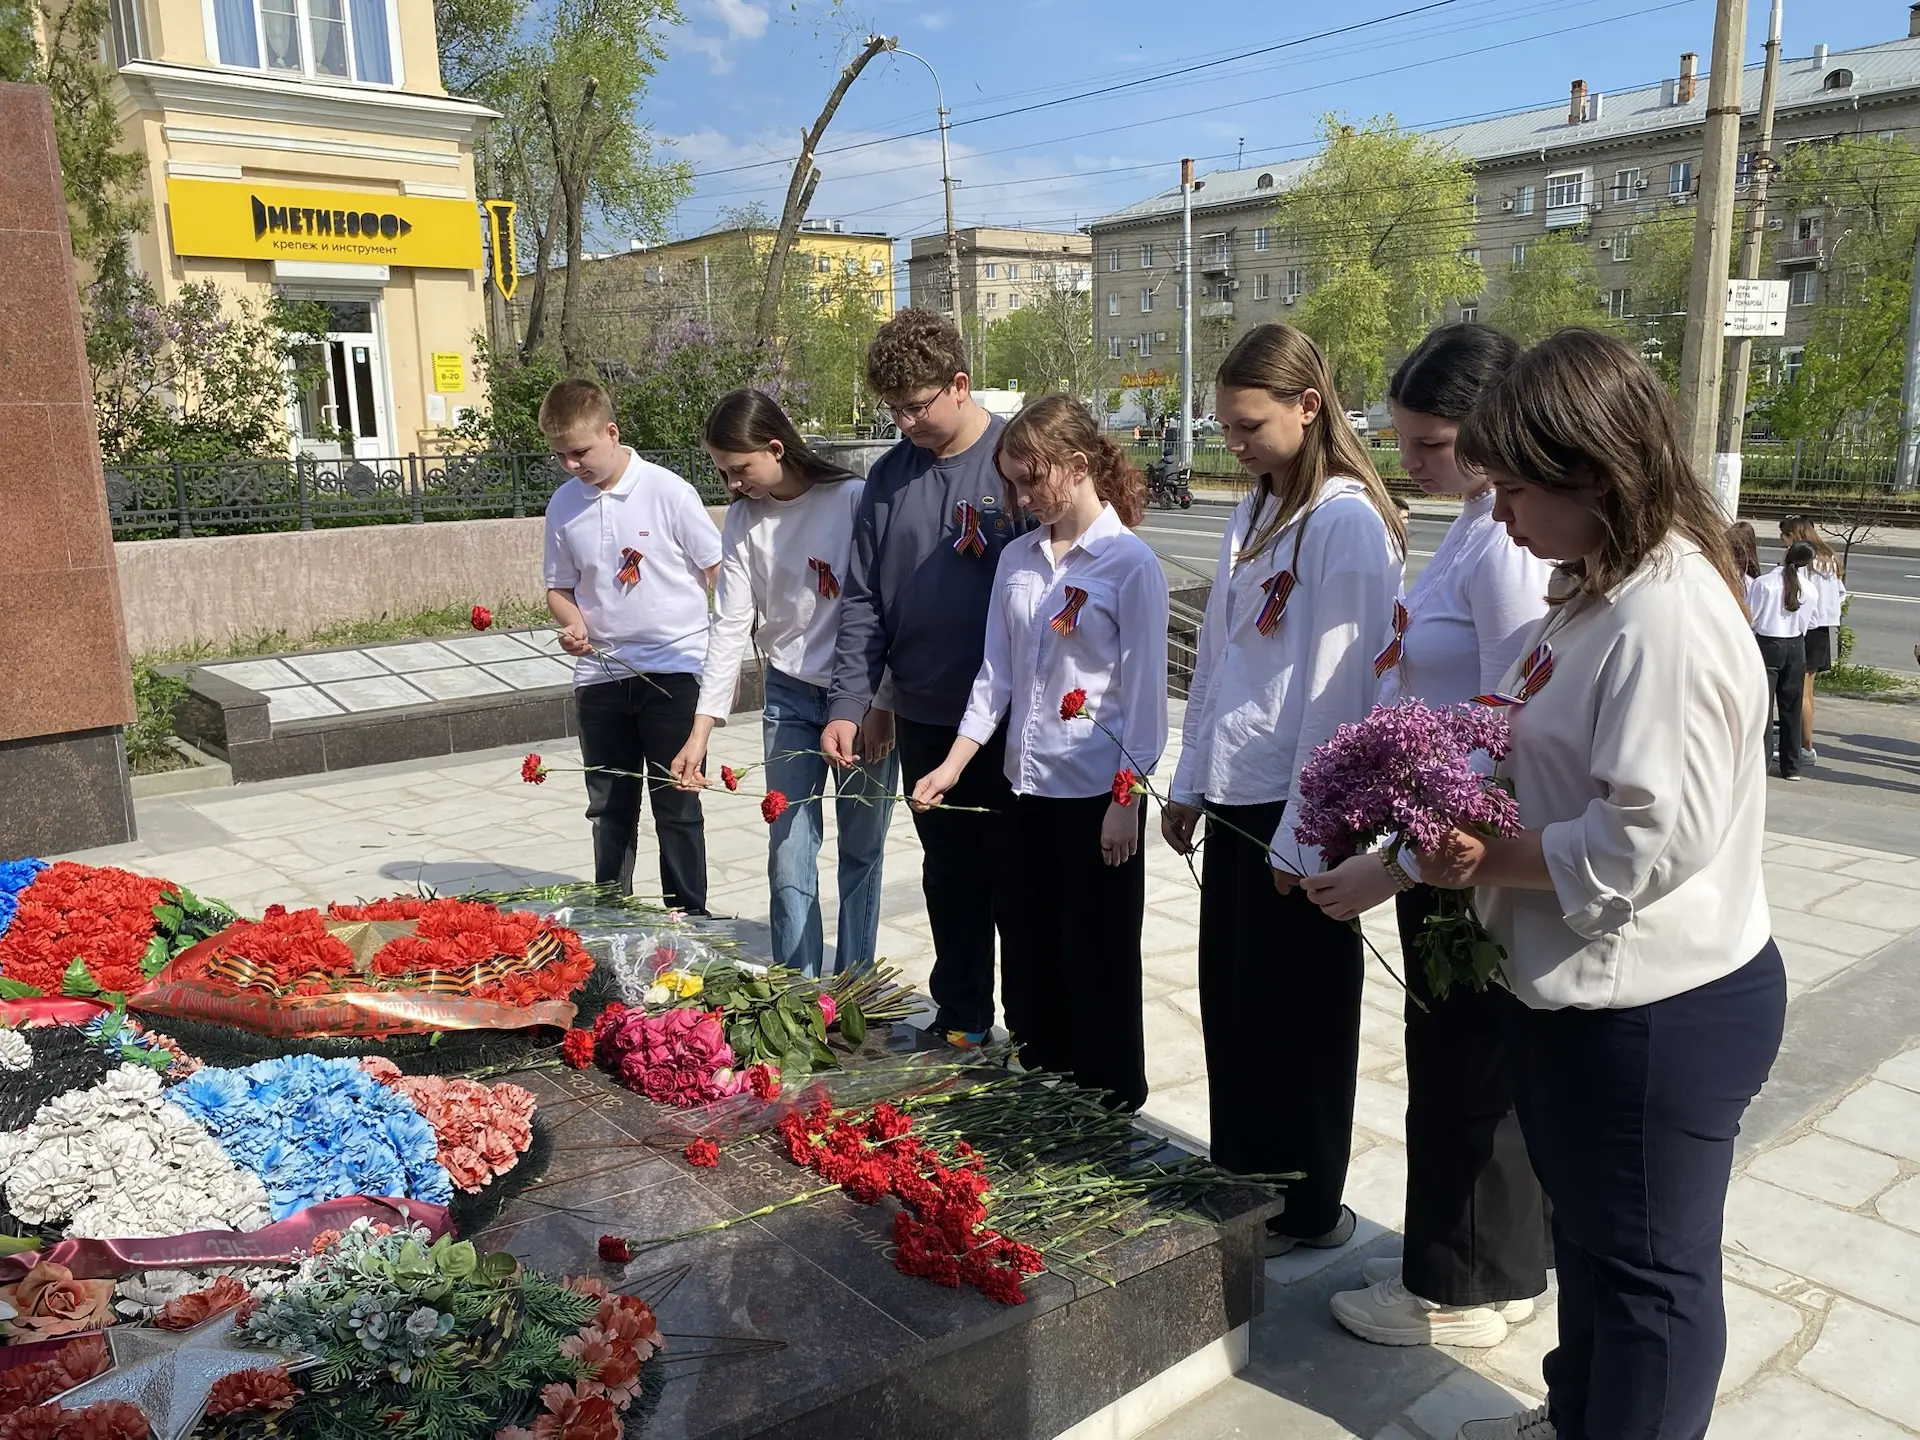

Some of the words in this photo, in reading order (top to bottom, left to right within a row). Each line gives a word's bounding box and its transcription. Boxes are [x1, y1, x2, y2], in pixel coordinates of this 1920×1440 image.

[273, 240, 318, 251] крепеж
[322, 243, 329, 251] и
[331, 243, 398, 255] инструмент
